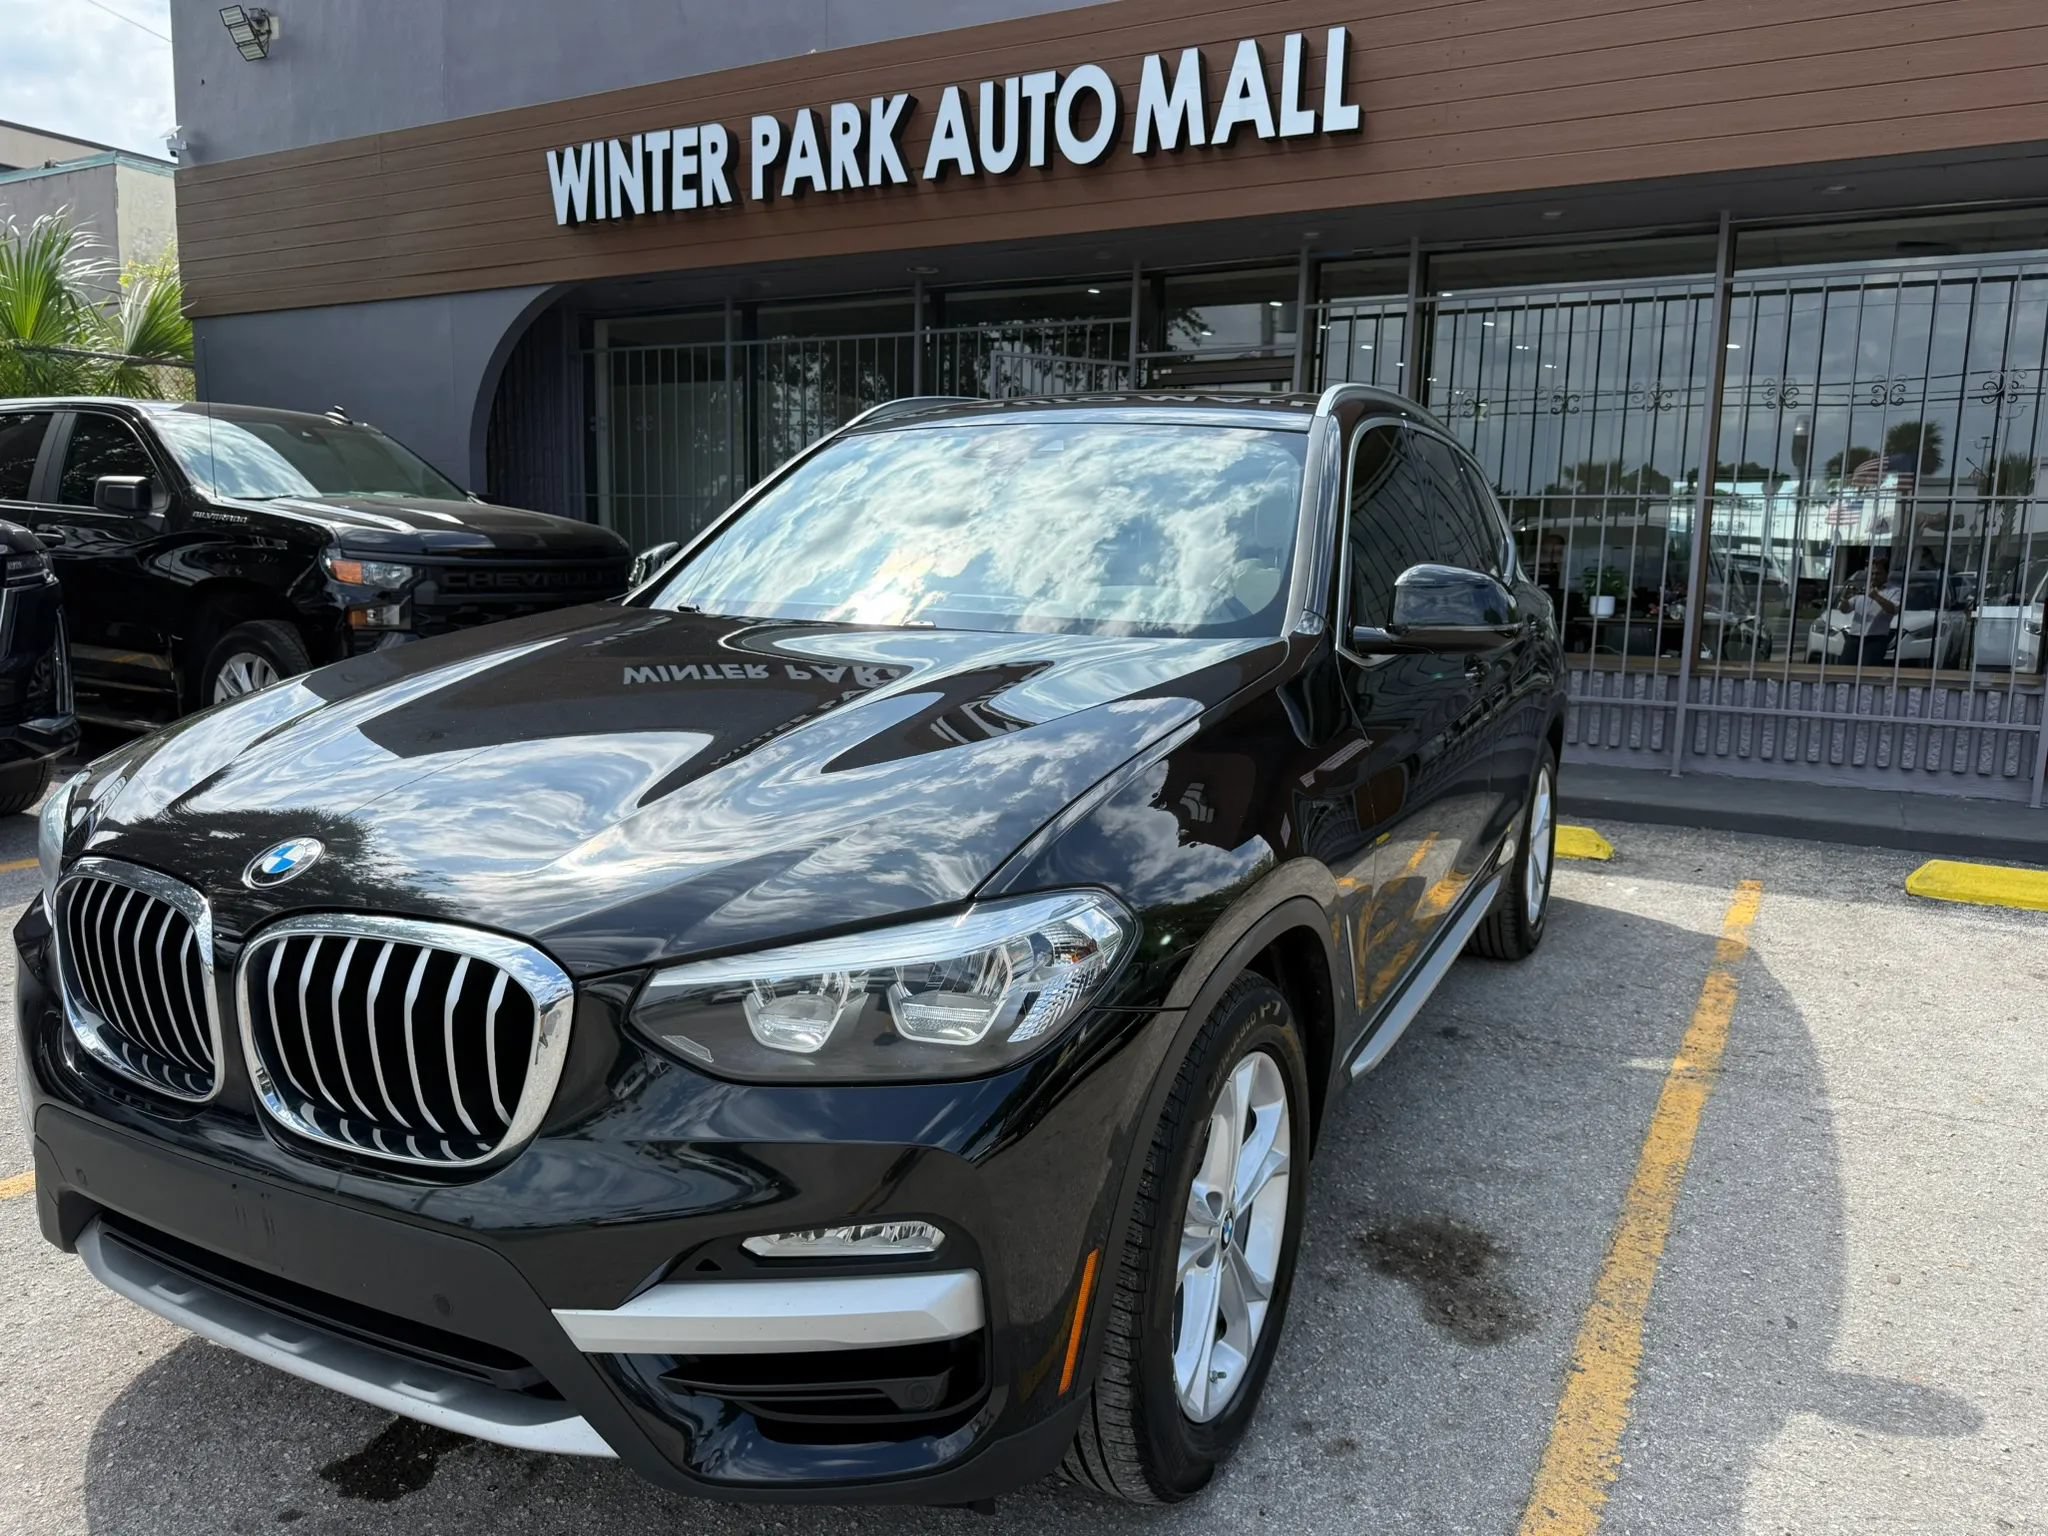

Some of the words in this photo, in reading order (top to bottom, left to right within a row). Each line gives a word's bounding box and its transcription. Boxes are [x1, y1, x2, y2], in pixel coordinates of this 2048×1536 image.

[546, 123, 733, 226] WINTER
[751, 94, 910, 200] PARK
[921, 64, 1117, 180] AUTO
[1132, 26, 1360, 154] MALL
